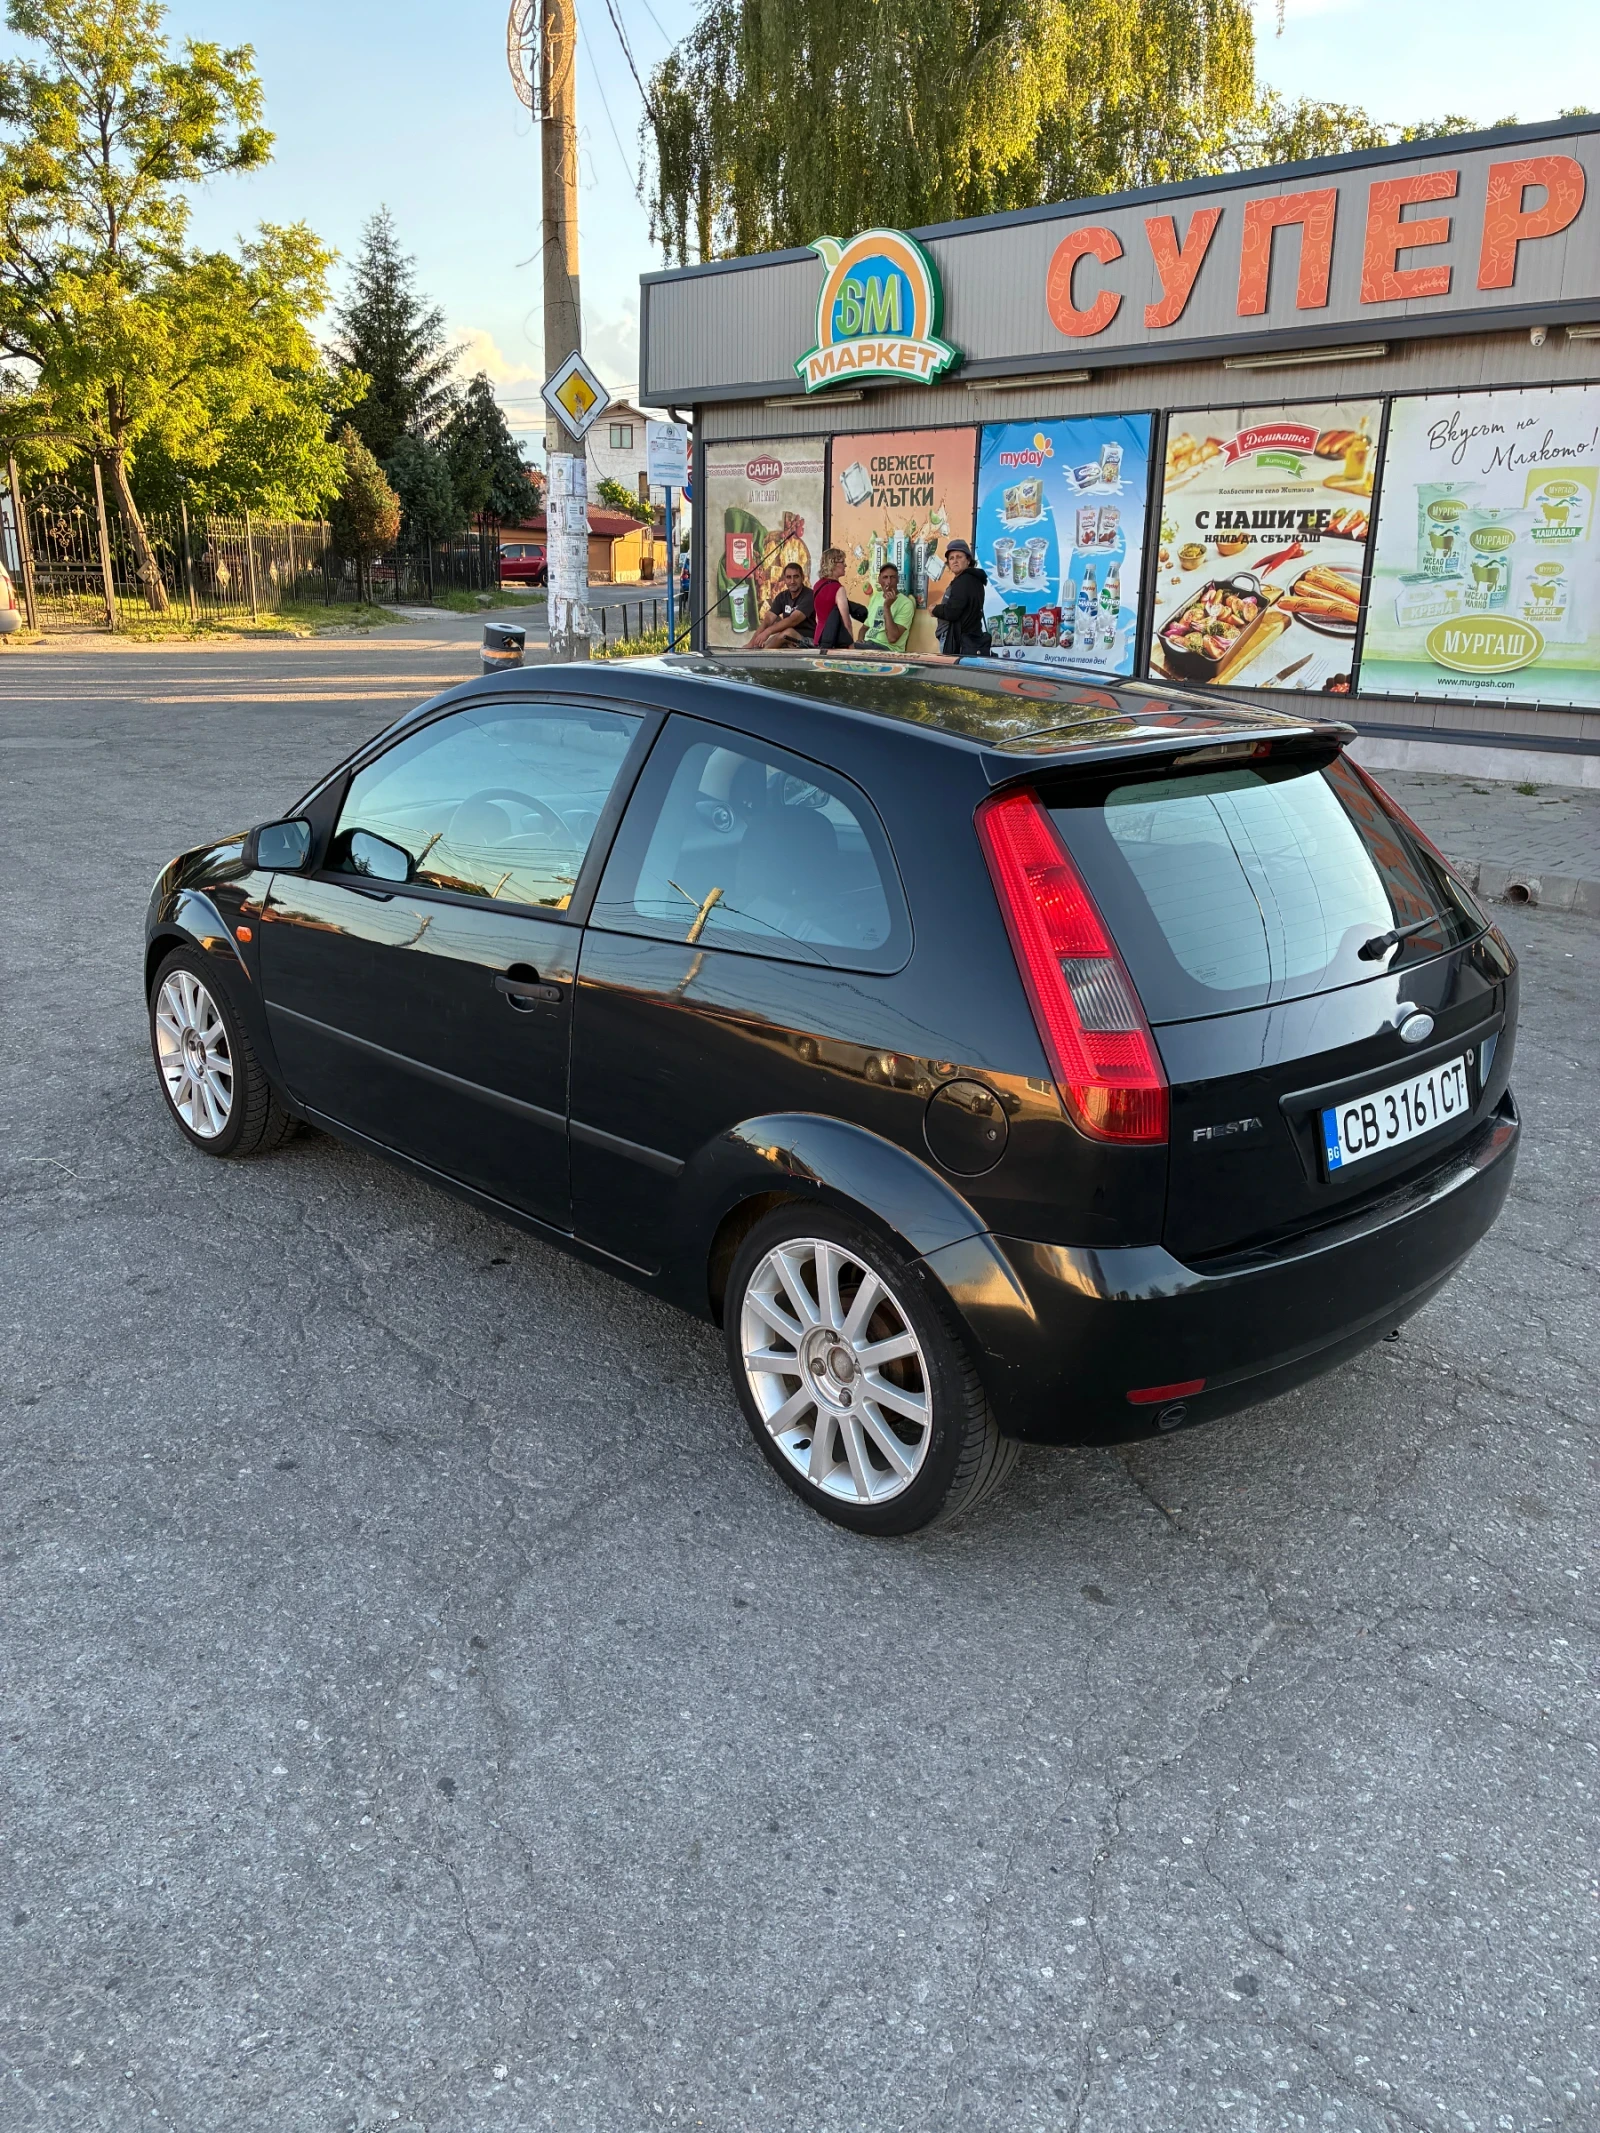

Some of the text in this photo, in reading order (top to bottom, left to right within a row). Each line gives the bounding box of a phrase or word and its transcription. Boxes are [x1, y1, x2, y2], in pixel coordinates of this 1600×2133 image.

[1045, 155, 1586, 337] СУПЕР
[809, 343, 937, 381] МАРКЕТ
[1244, 432, 1310, 448] Деликатес
[1427, 411, 1540, 465] Вкусът на
[870, 454, 935, 472] СВЕЖЕСТ
[1001, 448, 1044, 468] myday
[748, 463, 780, 476] САЯНА
[870, 472, 934, 486] НА ГОЛЕМИ
[870, 487, 934, 507] ГЛЪТКИ
[1195, 509, 1331, 529] С НАШИТЕ
[1204, 534, 1321, 544] НЯМА ДА СБЪРКАШ
[1475, 534, 1511, 545] МУРГАШ
[1536, 528, 1576, 537] КАШКАВАЛ
[1411, 601, 1453, 618] КРЕМА
[1443, 630, 1526, 655] МУРГАШ
[1437, 678, 1515, 689] www.murgash.com
[1193, 1117, 1263, 1142] FIESTA
[1327, 1146, 1340, 1162] BG
